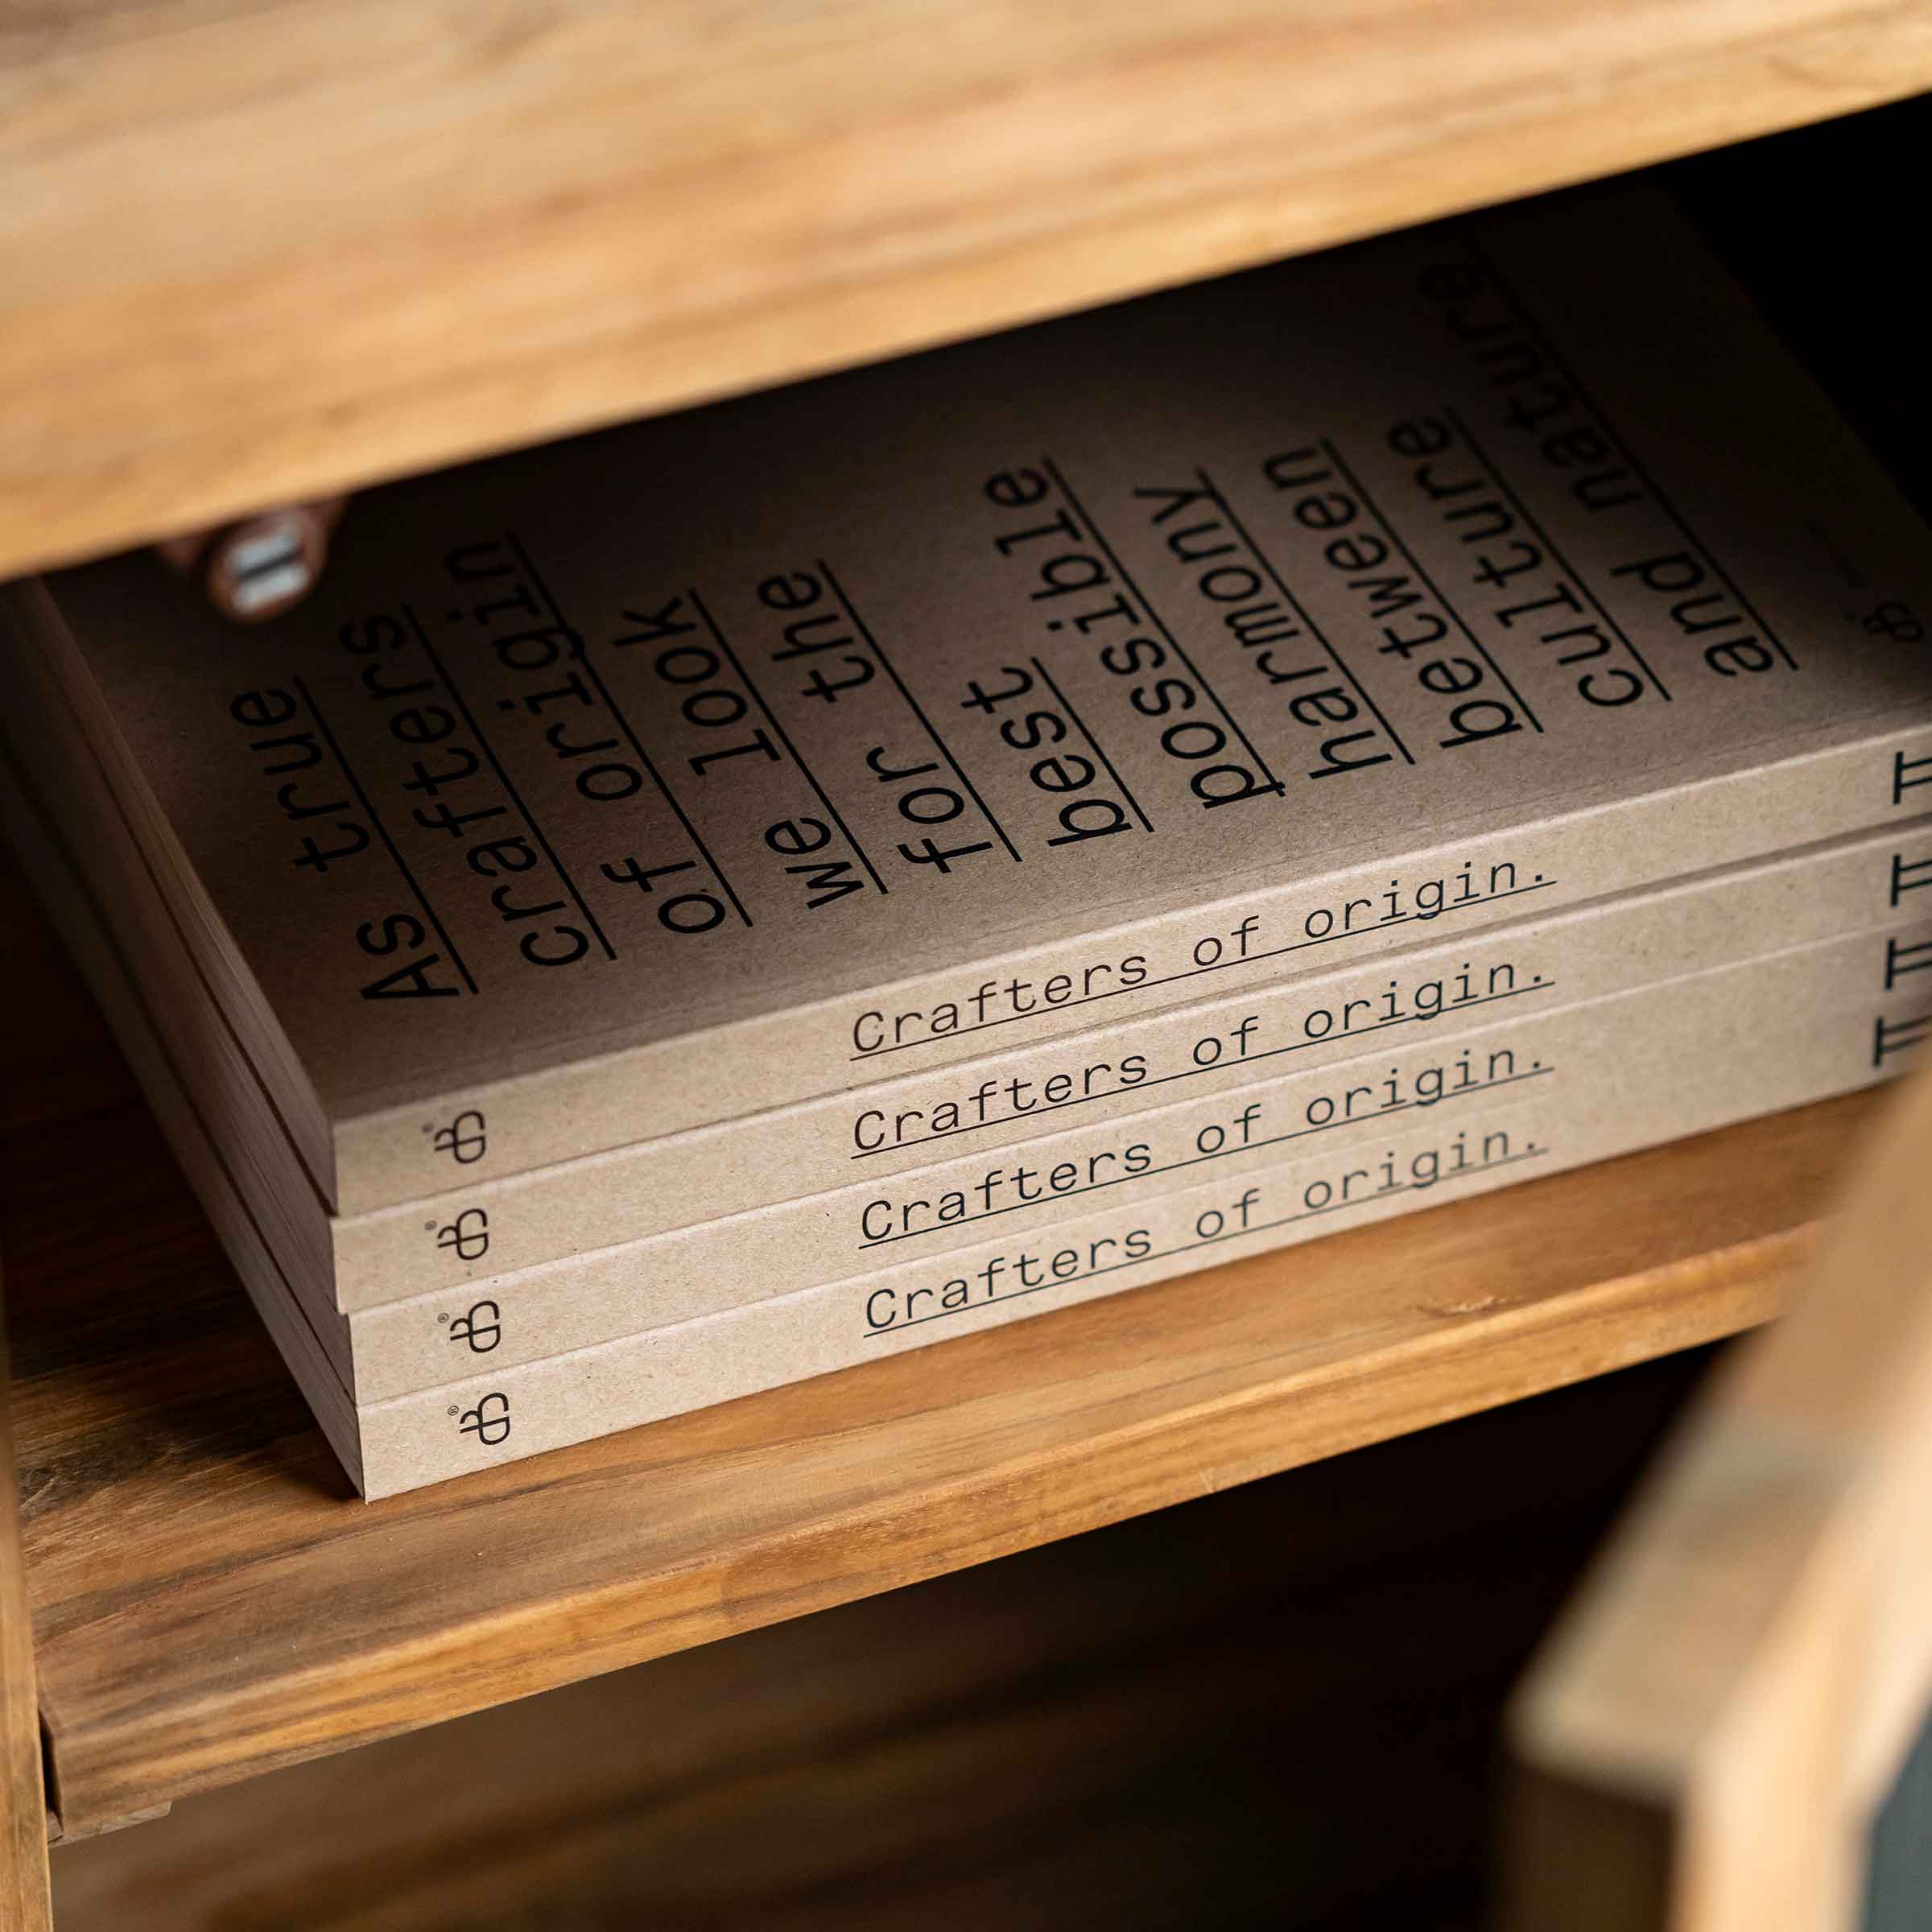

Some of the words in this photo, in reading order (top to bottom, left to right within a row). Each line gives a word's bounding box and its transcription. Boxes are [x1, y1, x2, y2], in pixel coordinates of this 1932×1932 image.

[758, 572, 876, 703] the
[984, 469, 1286, 808] possible
[1134, 487, 1392, 778] harmony
[1264, 449, 1522, 747] between
[1387, 416, 1643, 706] culture
[1614, 552, 1773, 675] and
[445, 542, 642, 801] origin
[615, 597, 780, 775] look
[962, 667, 1132, 846] best
[230, 688, 369, 872] true
[341, 613, 588, 966] crafters
[764, 818, 865, 909] we
[867, 747, 993, 873] for
[356, 914, 459, 999] As
[601, 858, 725, 933] of
[853, 955, 1147, 1053] Crafters
[1193, 916, 1259, 967] of
[1305, 858, 1544, 939] origin.
[854, 1055, 1147, 1151] Crafters
[1193, 1017, 1258, 1066] of
[1304, 960, 1543, 1038] origin.
[861, 1142, 1151, 1241] Crafters
[1197, 1104, 1261, 1154] of
[1307, 1045, 1542, 1125] origin.
[866, 1224, 1151, 1329] Crafters
[1197, 1191, 1259, 1239] of
[1305, 1126, 1538, 1209] origin.
